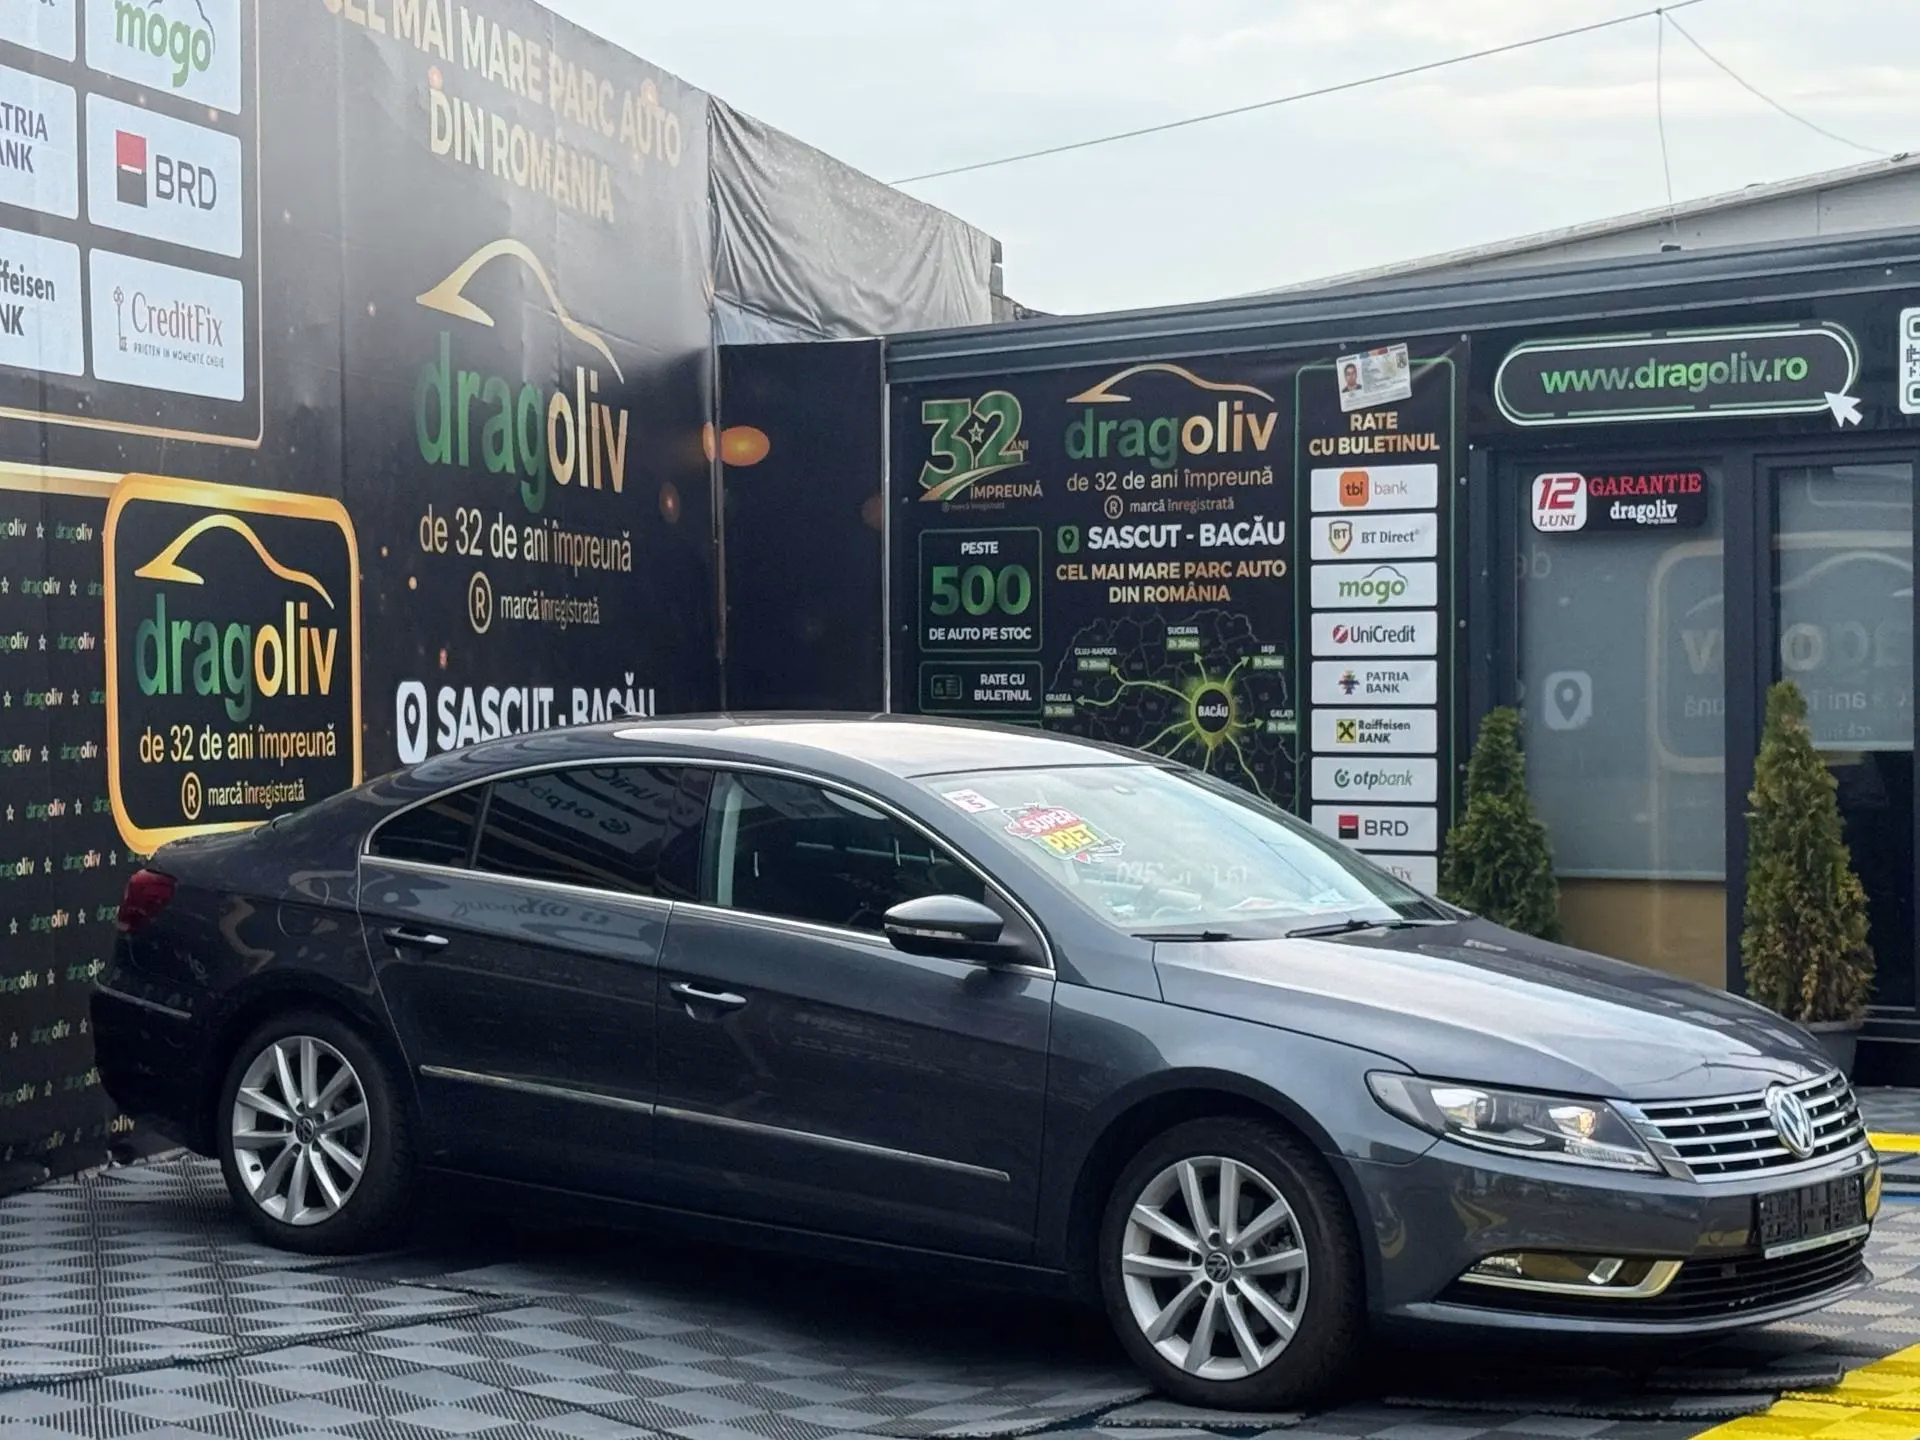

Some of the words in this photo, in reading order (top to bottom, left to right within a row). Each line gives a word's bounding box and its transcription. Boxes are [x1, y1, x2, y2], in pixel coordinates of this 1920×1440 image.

[115, 1, 212, 87] mogo
[460, 5, 544, 104] MARE
[549, 51, 615, 138] PARC
[620, 90, 682, 167] AUTO
[430, 87, 485, 170] DIN
[155, 154, 217, 212] BRD
[131, 292, 224, 348] CreditFix
[1540, 350, 1808, 395] www.dragoliv.ro
[415, 331, 629, 514] dragoliv
[1350, 411, 1398, 431] RATE
[919, 391, 1022, 490] 32
[1064, 400, 1279, 469] dragoliv
[1309, 437, 1335, 456] CU
[1337, 432, 1440, 456] BULETINUL
[1066, 473, 1089, 491] de
[1094, 472, 1118, 491] 32
[1122, 470, 1146, 490] de
[1150, 470, 1179, 489] ani
[1184, 466, 1274, 491] împreună
[1345, 481, 1364, 497] tbi
[1374, 479, 1408, 496] bank
[1537, 477, 1581, 510] 12
[1588, 473, 1702, 496] GARANTIE
[1130, 499, 1166, 513] marcă
[1609, 499, 1678, 523] dragoliv
[1087, 524, 1182, 550] SASCUT
[1199, 515, 1286, 548] BACĂU
[1538, 514, 1576, 528] LUNI
[419, 503, 449, 554] de
[455, 506, 483, 556] 32
[490, 511, 518, 560] de
[523, 518, 549, 563] ani
[552, 519, 632, 578] împreună
[1333, 528, 1348, 540] BT
[1361, 531, 1377, 544] BT
[961, 541, 999, 555] PESTE
[1056, 564, 1088, 581] CEL
[1092, 563, 1125, 580] MAI
[1128, 562, 1181, 580] MARE
[1184, 561, 1233, 579] PARC
[1236, 559, 1288, 578] AUTO
[930, 564, 1032, 616] 500
[1109, 586, 1141, 603] DIN
[1144, 581, 1232, 602] ROMÂNIA
[1338, 578, 1407, 605] mogo
[928, 628, 944, 640] DE
[947, 628, 980, 640] AUTO
[981, 628, 997, 640] PE
[999, 627, 1031, 640] STOC
[1350, 624, 1416, 644] UniCredit
[135, 592, 338, 722] dragoliv
[980, 674, 1008, 685] RATE
[1009, 673, 1025, 686] CU
[1366, 671, 1410, 682] PATRIA
[1366, 683, 1401, 694] BANK
[973, 690, 1032, 701] BULETINUL
[1358, 719, 1411, 731] Raiffeisen
[139, 726, 165, 764] de
[170, 725, 194, 762] 32
[199, 724, 222, 761] de
[227, 724, 254, 760] ani
[258, 722, 336, 767] împreună
[1358, 732, 1391, 744] BANK
[1354, 769, 1413, 790] otpbank
[207, 779, 243, 808] marcă
[1364, 819, 1409, 837] BRD
